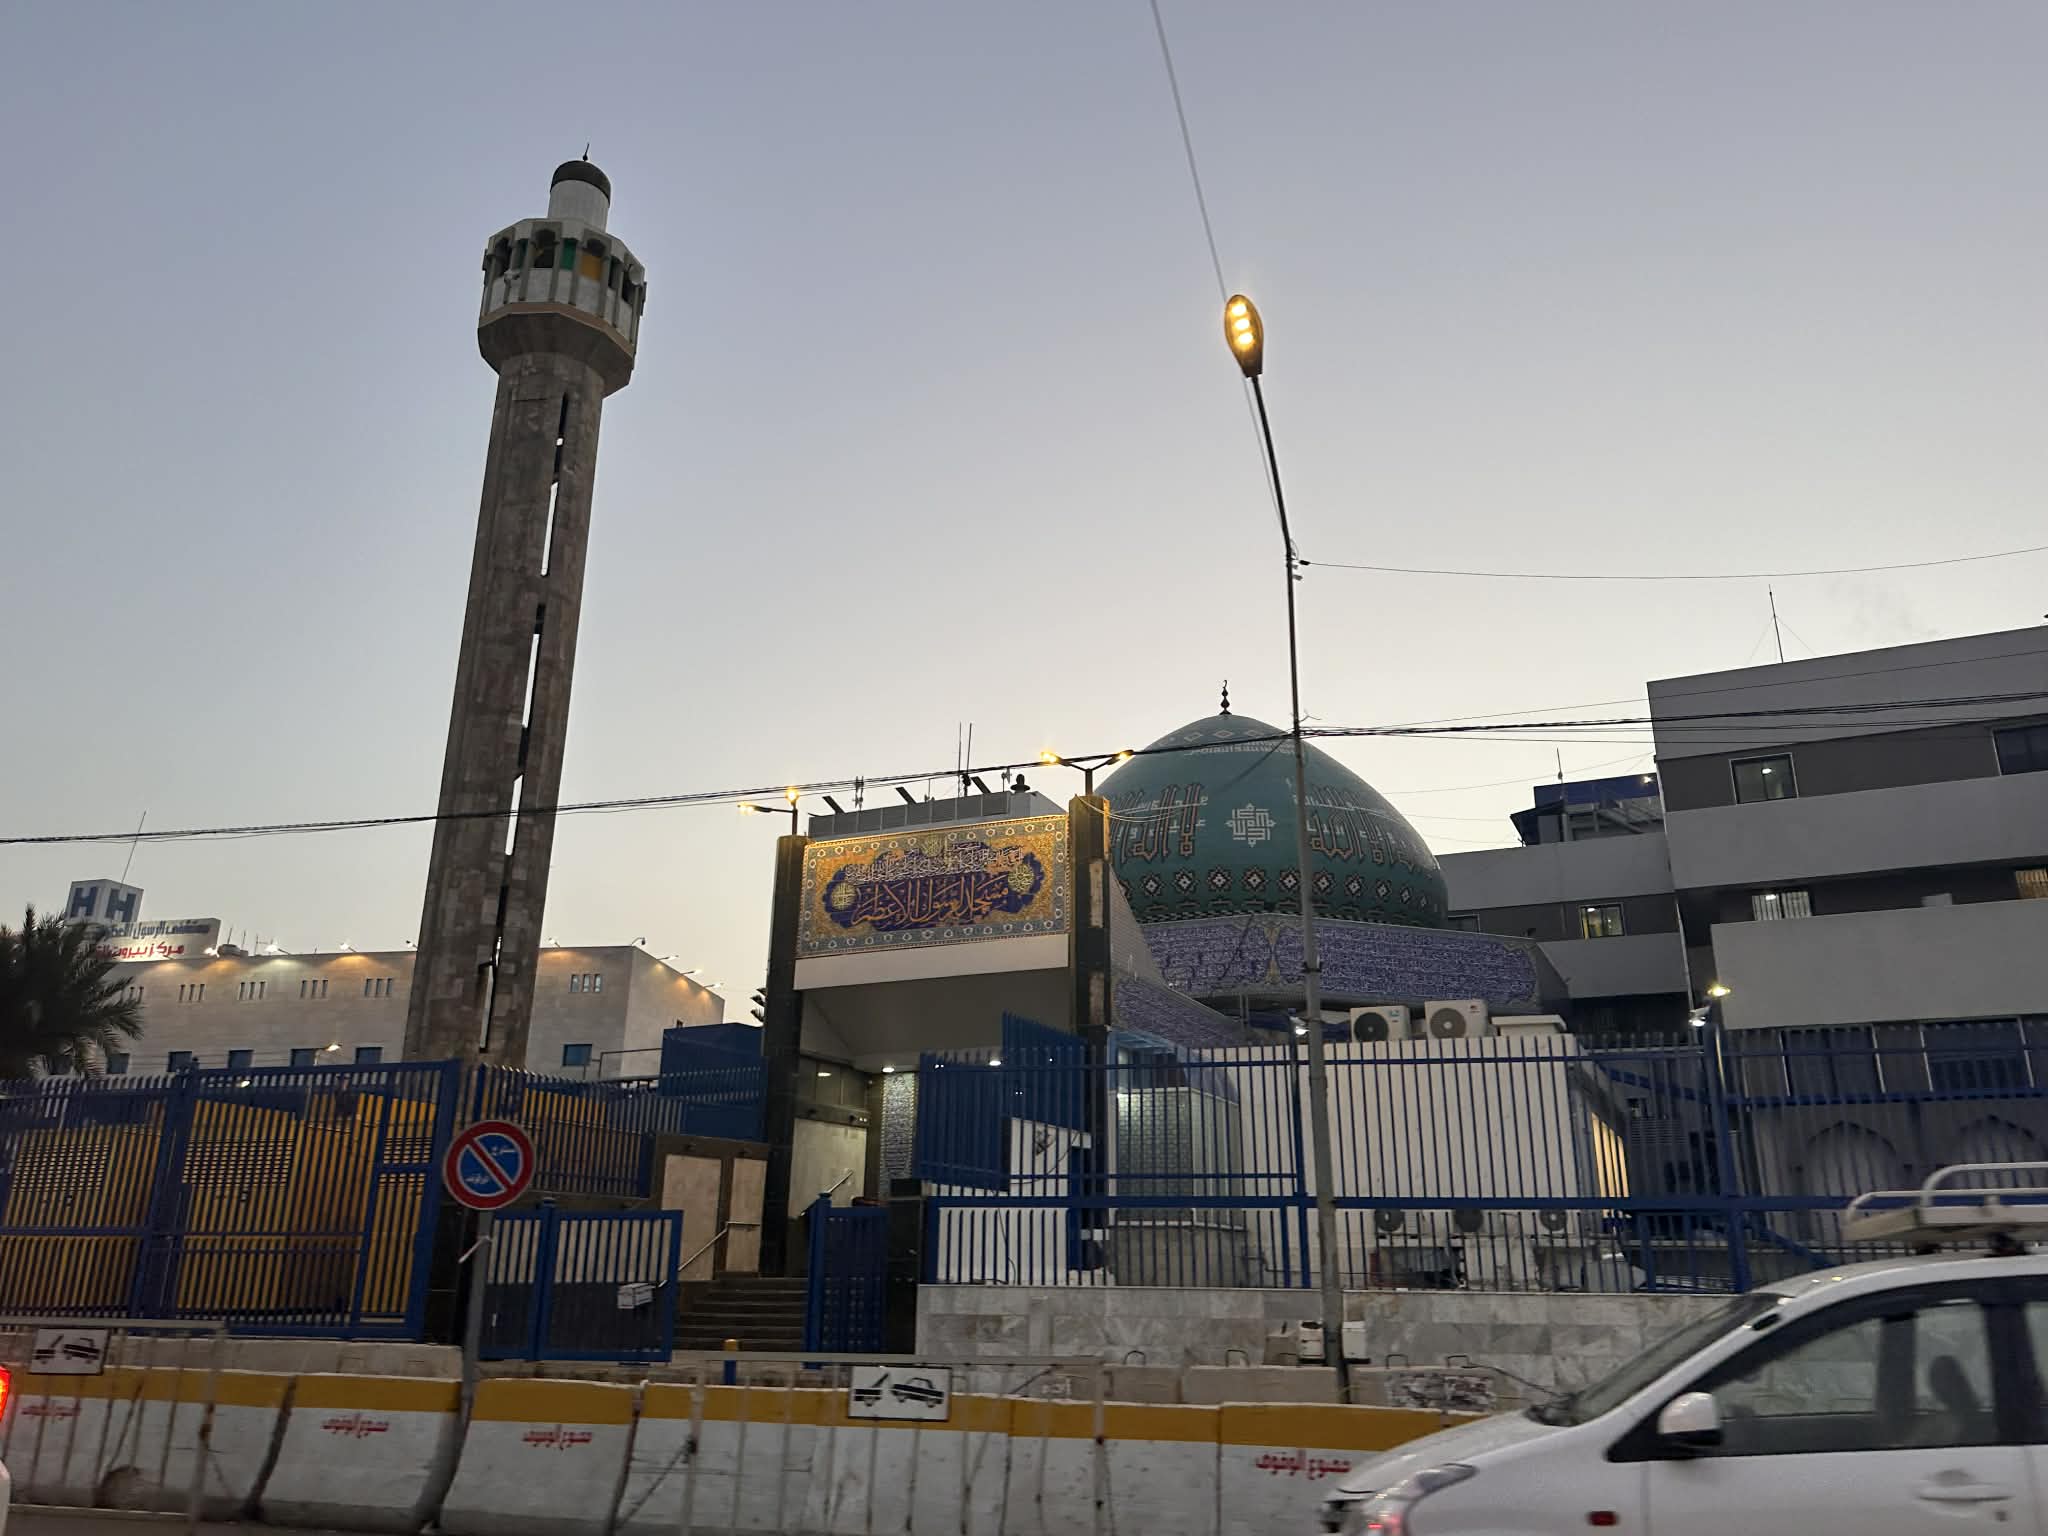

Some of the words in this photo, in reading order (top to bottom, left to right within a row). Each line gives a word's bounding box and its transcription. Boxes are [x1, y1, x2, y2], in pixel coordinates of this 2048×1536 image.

[70, 886, 97, 918] H
[105, 888, 137, 922] H
[133, 920, 166, 939] الرسول
[112, 943, 149, 959] بيروت
[148, 938, 185, 956] مركز
[1255, 1448, 1307, 1477] الوقوف
[1307, 1458, 1351, 1481] ممنوع
